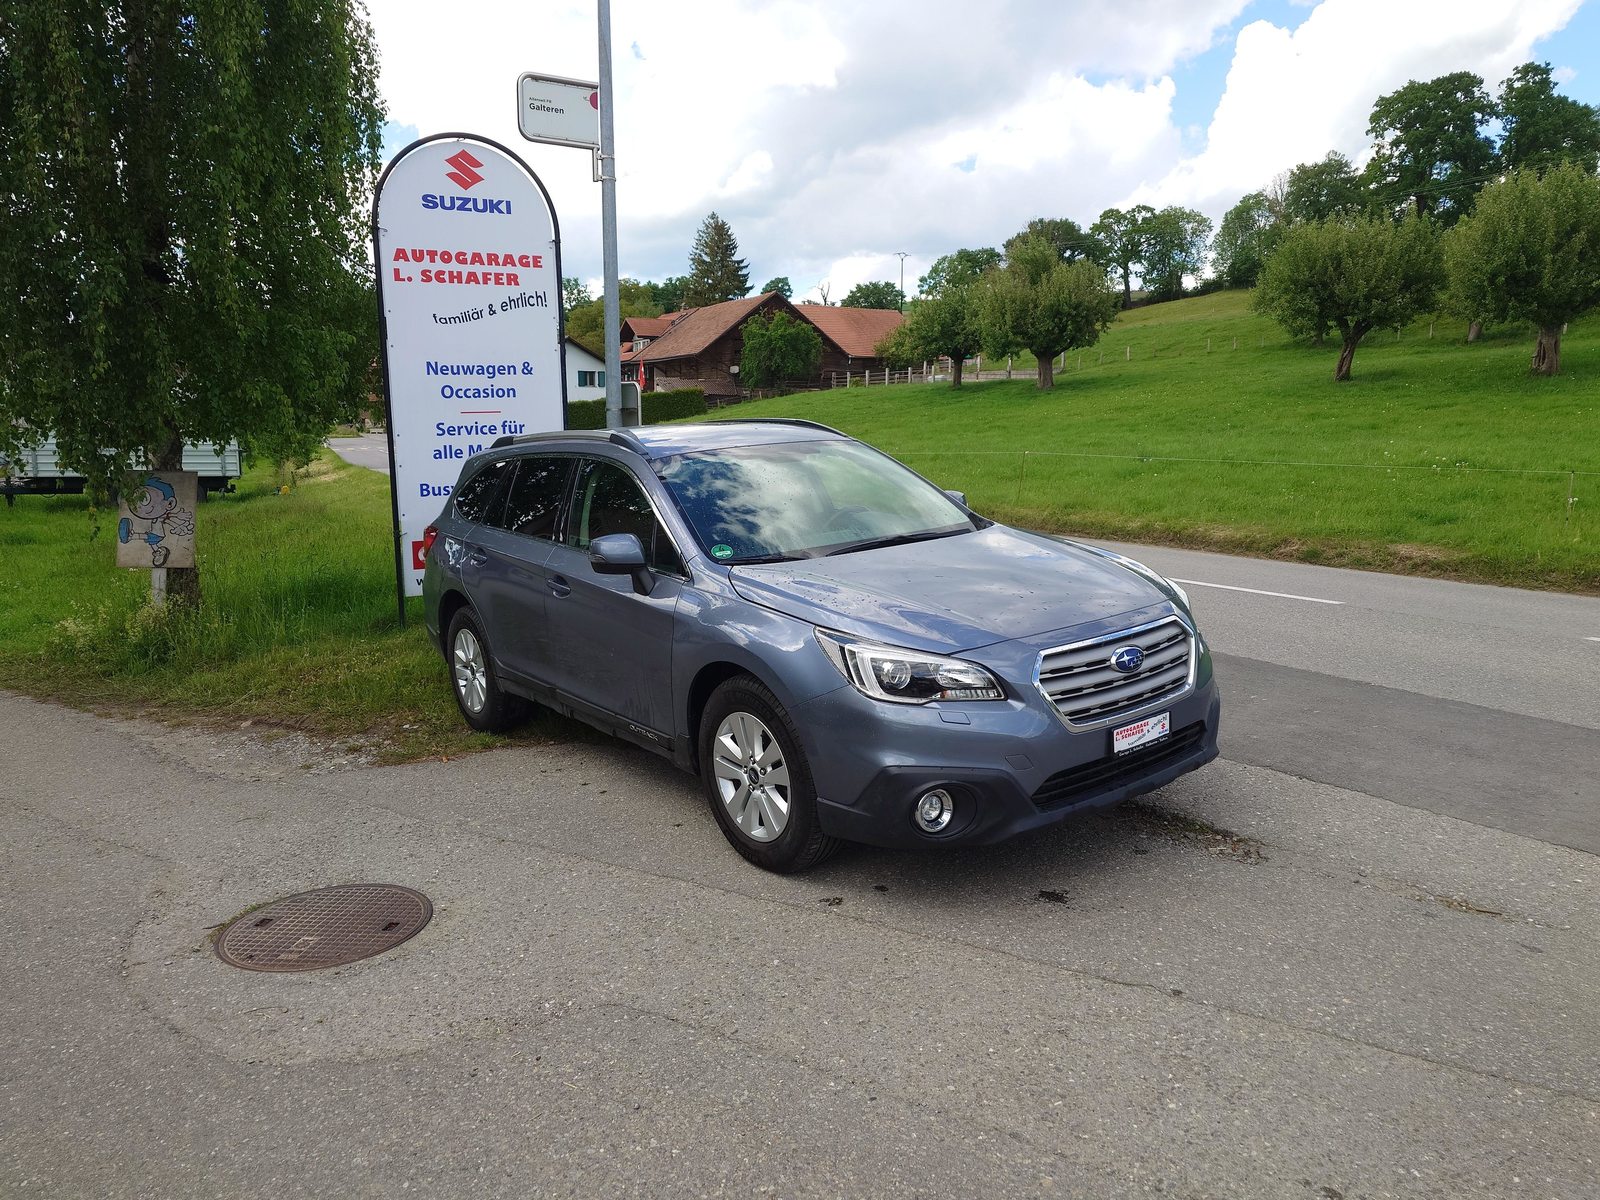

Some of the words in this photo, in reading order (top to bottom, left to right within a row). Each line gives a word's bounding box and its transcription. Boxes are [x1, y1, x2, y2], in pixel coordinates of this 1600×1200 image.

[529, 102, 565, 114] Galteren
[421, 194, 512, 215] SUZUKI
[393, 247, 543, 268] AUTOGARAGE
[393, 268, 413, 282] L.
[420, 269, 520, 286] SCHAFER
[432, 304, 484, 325] familiär
[488, 303, 497, 316] &
[500, 291, 548, 312] ehrlich!
[426, 361, 517, 379] Neuwagen
[521, 361, 534, 375] &
[440, 384, 517, 399] Occasion
[436, 421, 497, 436] Service
[501, 420, 525, 435] für
[432, 445, 464, 460] alle
[468, 444, 490, 457] M
[419, 483, 455, 497] Bus
[1115, 721, 1150, 737] AUTOGARAGE
